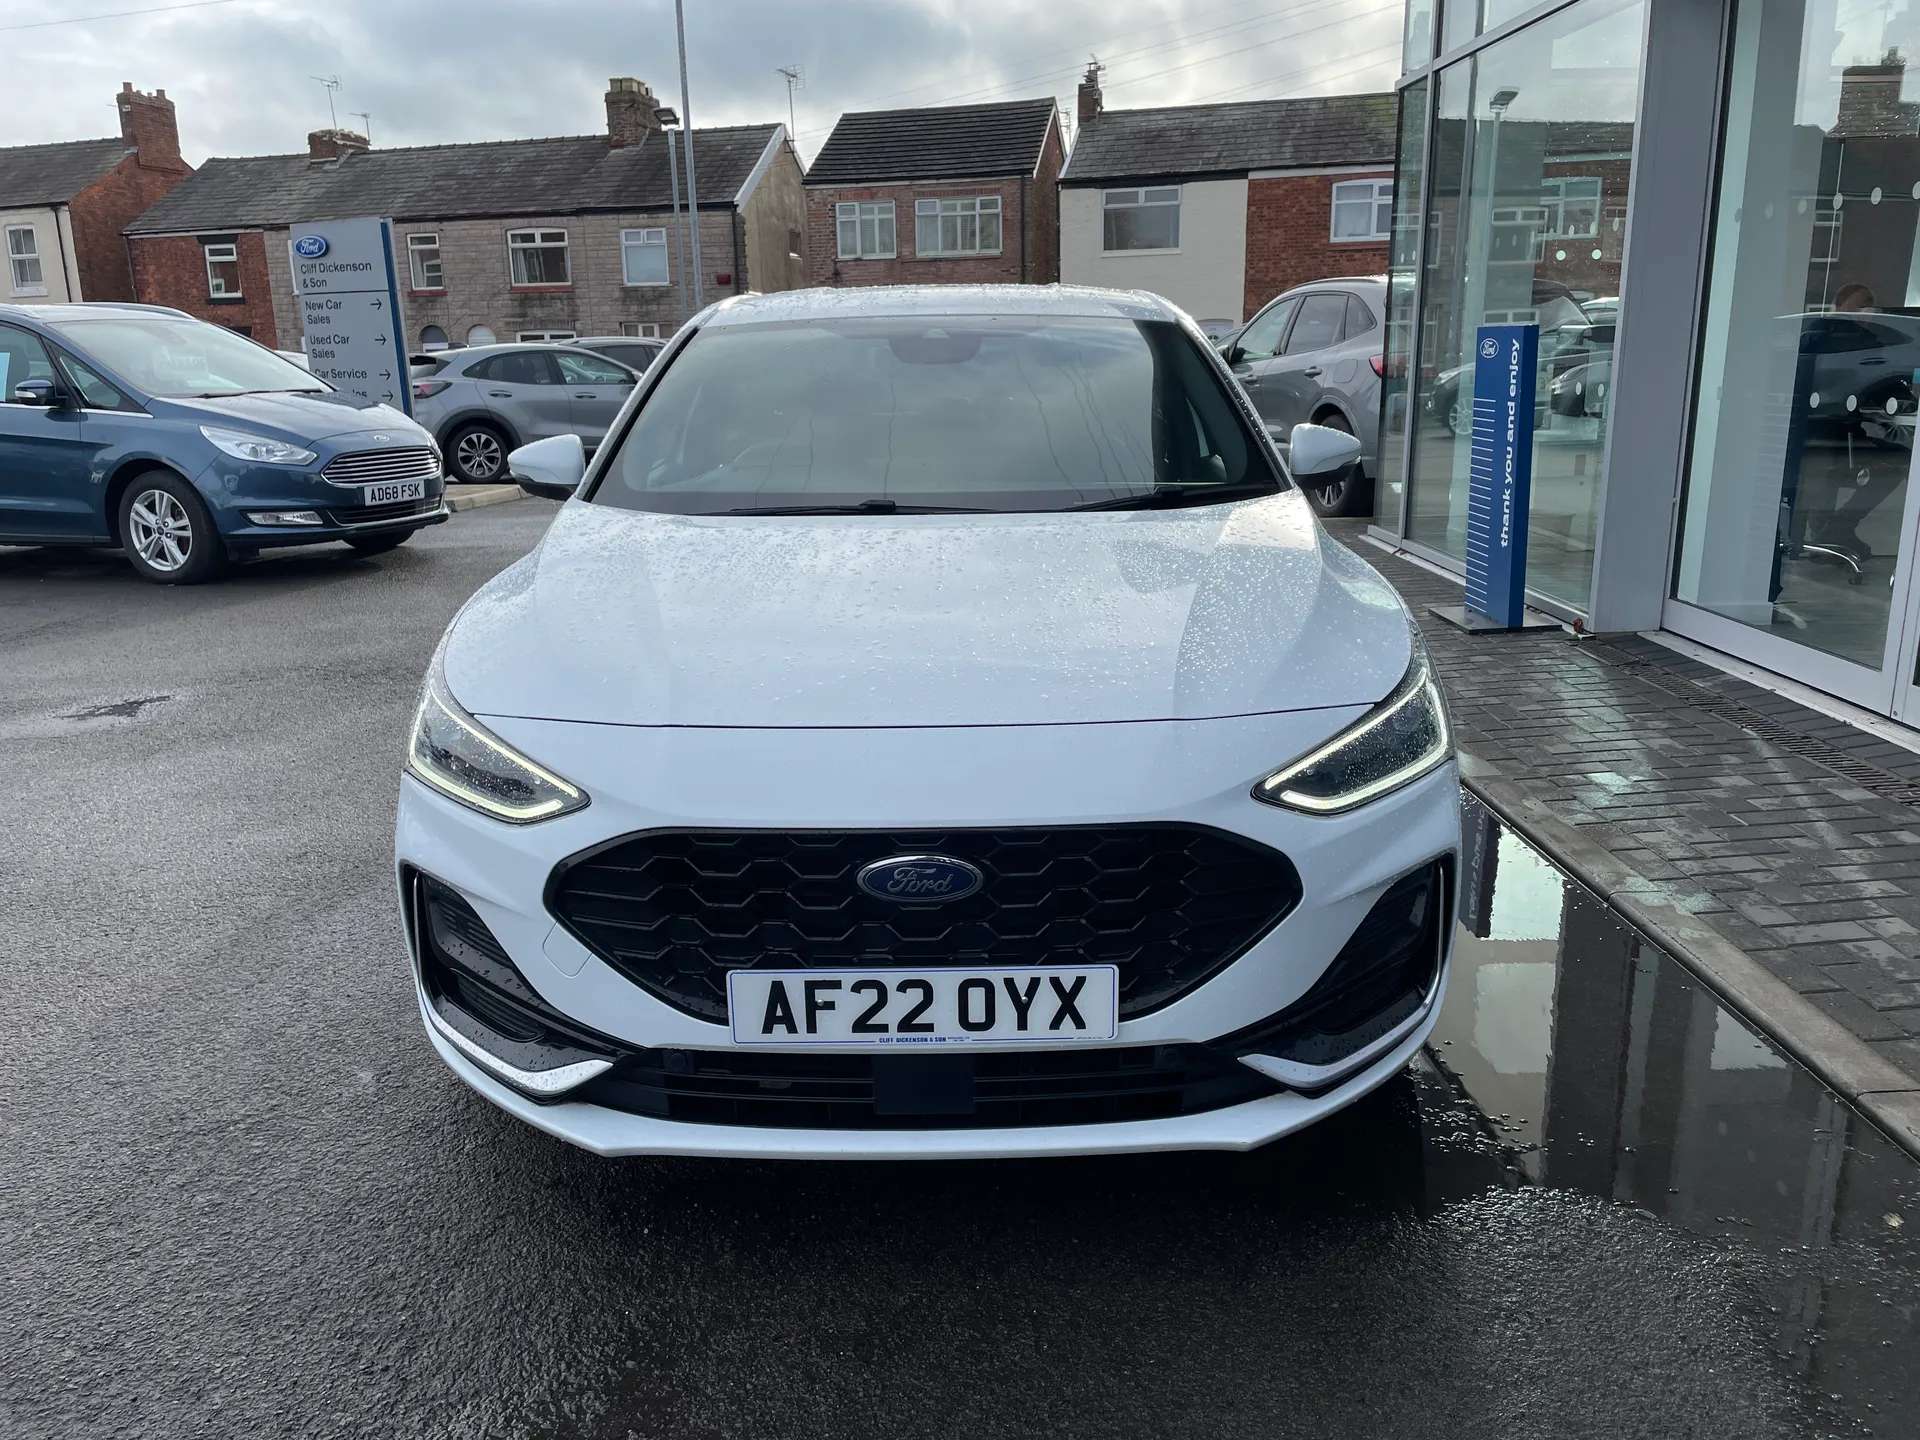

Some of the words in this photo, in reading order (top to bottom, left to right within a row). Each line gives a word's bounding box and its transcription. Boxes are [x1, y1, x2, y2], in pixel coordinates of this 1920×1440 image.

[300, 239, 320, 254] Ford
[300, 263, 317, 275] Cliff
[319, 261, 372, 273] Dickenson
[302, 279, 309, 288] &
[310, 278, 327, 288] Son
[305, 300, 324, 311] New
[326, 299, 342, 310] Car
[307, 314, 331, 325] Sales
[310, 334, 332, 345] Used
[333, 334, 350, 345] Car
[312, 348, 335, 359] Sales
[331, 368, 368, 379] Service
[1508, 338, 1520, 399] enjoy
[1506, 401, 1516, 442] and
[1503, 446, 1515, 485] you
[370, 485, 399, 503] AD68
[401, 482, 421, 499] FSK
[1501, 489, 1511, 547] thank
[887, 867, 954, 893] Ford
[760, 978, 935, 1035] AF22
[957, 975, 1087, 1032] OYX
